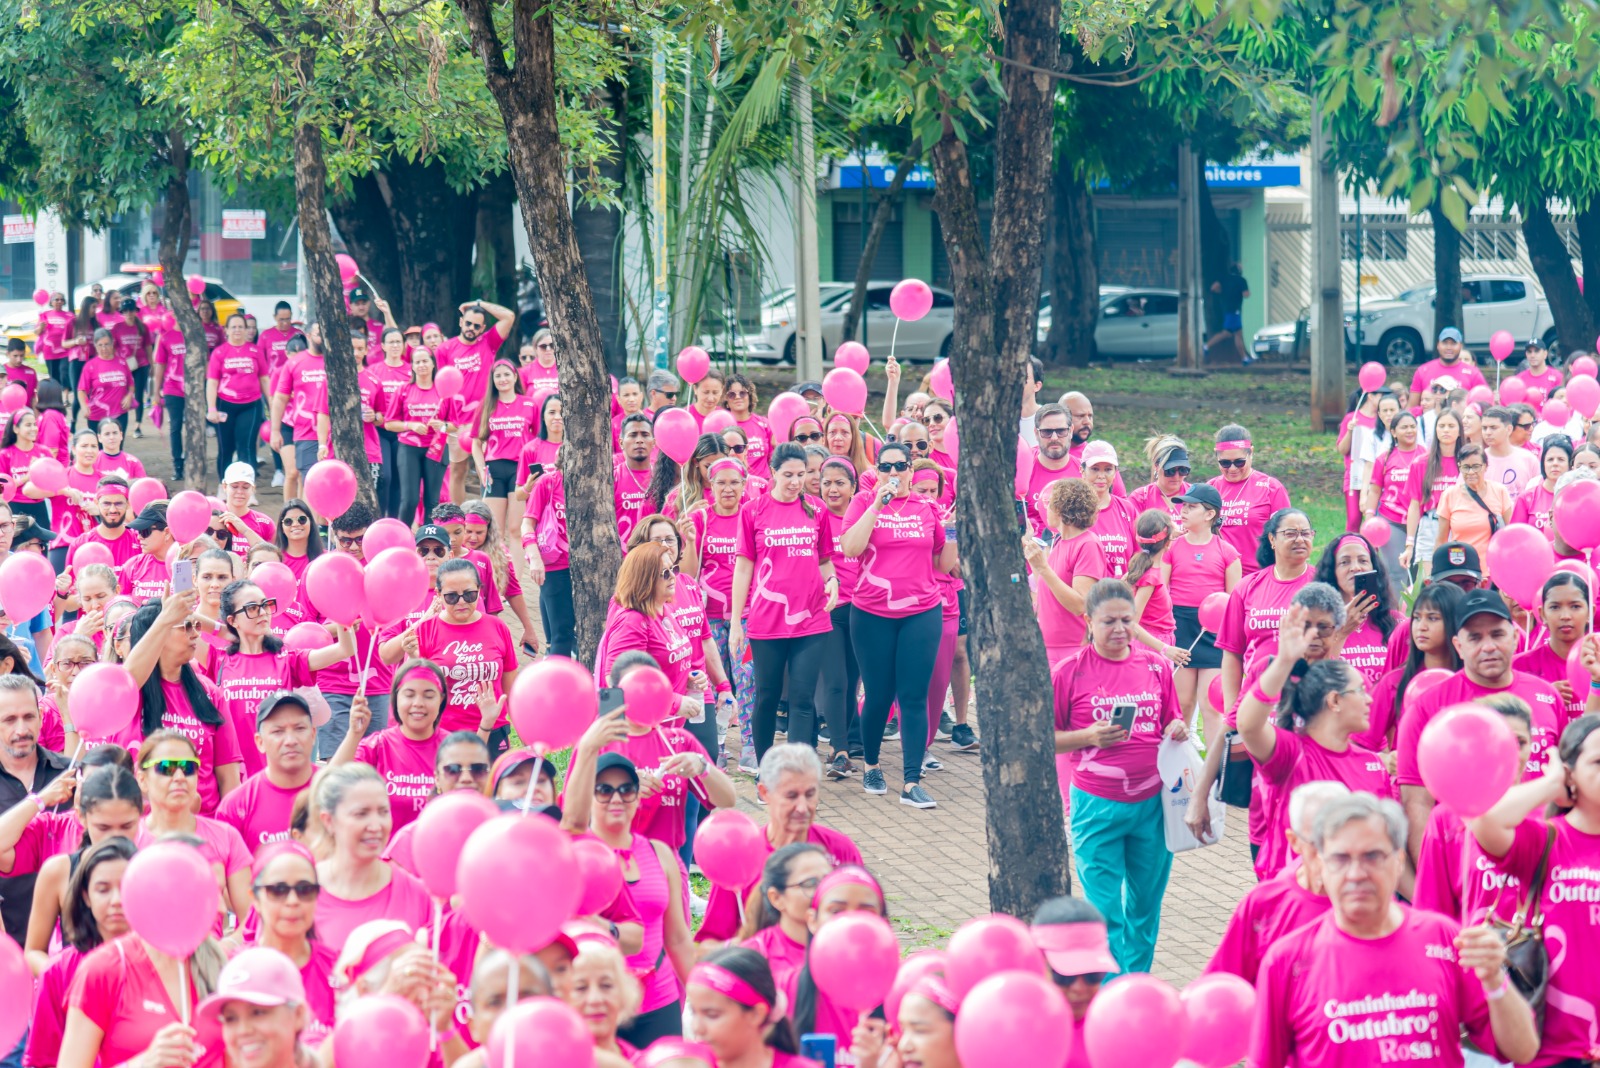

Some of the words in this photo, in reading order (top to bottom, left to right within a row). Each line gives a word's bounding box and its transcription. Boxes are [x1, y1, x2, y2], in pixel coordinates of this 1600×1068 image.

[1205, 167, 1262, 181] nitores
[5, 223, 34, 236] ALUGA
[225, 219, 265, 230] ALUGA
[622, 492, 646, 500] Camin
[764, 527, 811, 535] Caminhada
[893, 528, 919, 538] Rosa
[707, 536, 737, 544] Caminh
[764, 534, 811, 547] Outubro
[787, 546, 812, 558] Rosa
[1250, 607, 1289, 617] Caminh
[1249, 618, 1279, 630] Outu
[223, 677, 276, 688] Caminhada
[1091, 691, 1152, 706] Caminhada
[1131, 723, 1154, 738] osa
[387, 771, 434, 785] Caminha
[386, 782, 430, 797] Outub
[1551, 864, 1600, 881] Camin
[1549, 882, 1600, 903] Outu
[1324, 989, 1427, 1018] Caminhada
[1328, 1012, 1429, 1044] Outubro
[1378, 1038, 1433, 1063] Rosa
